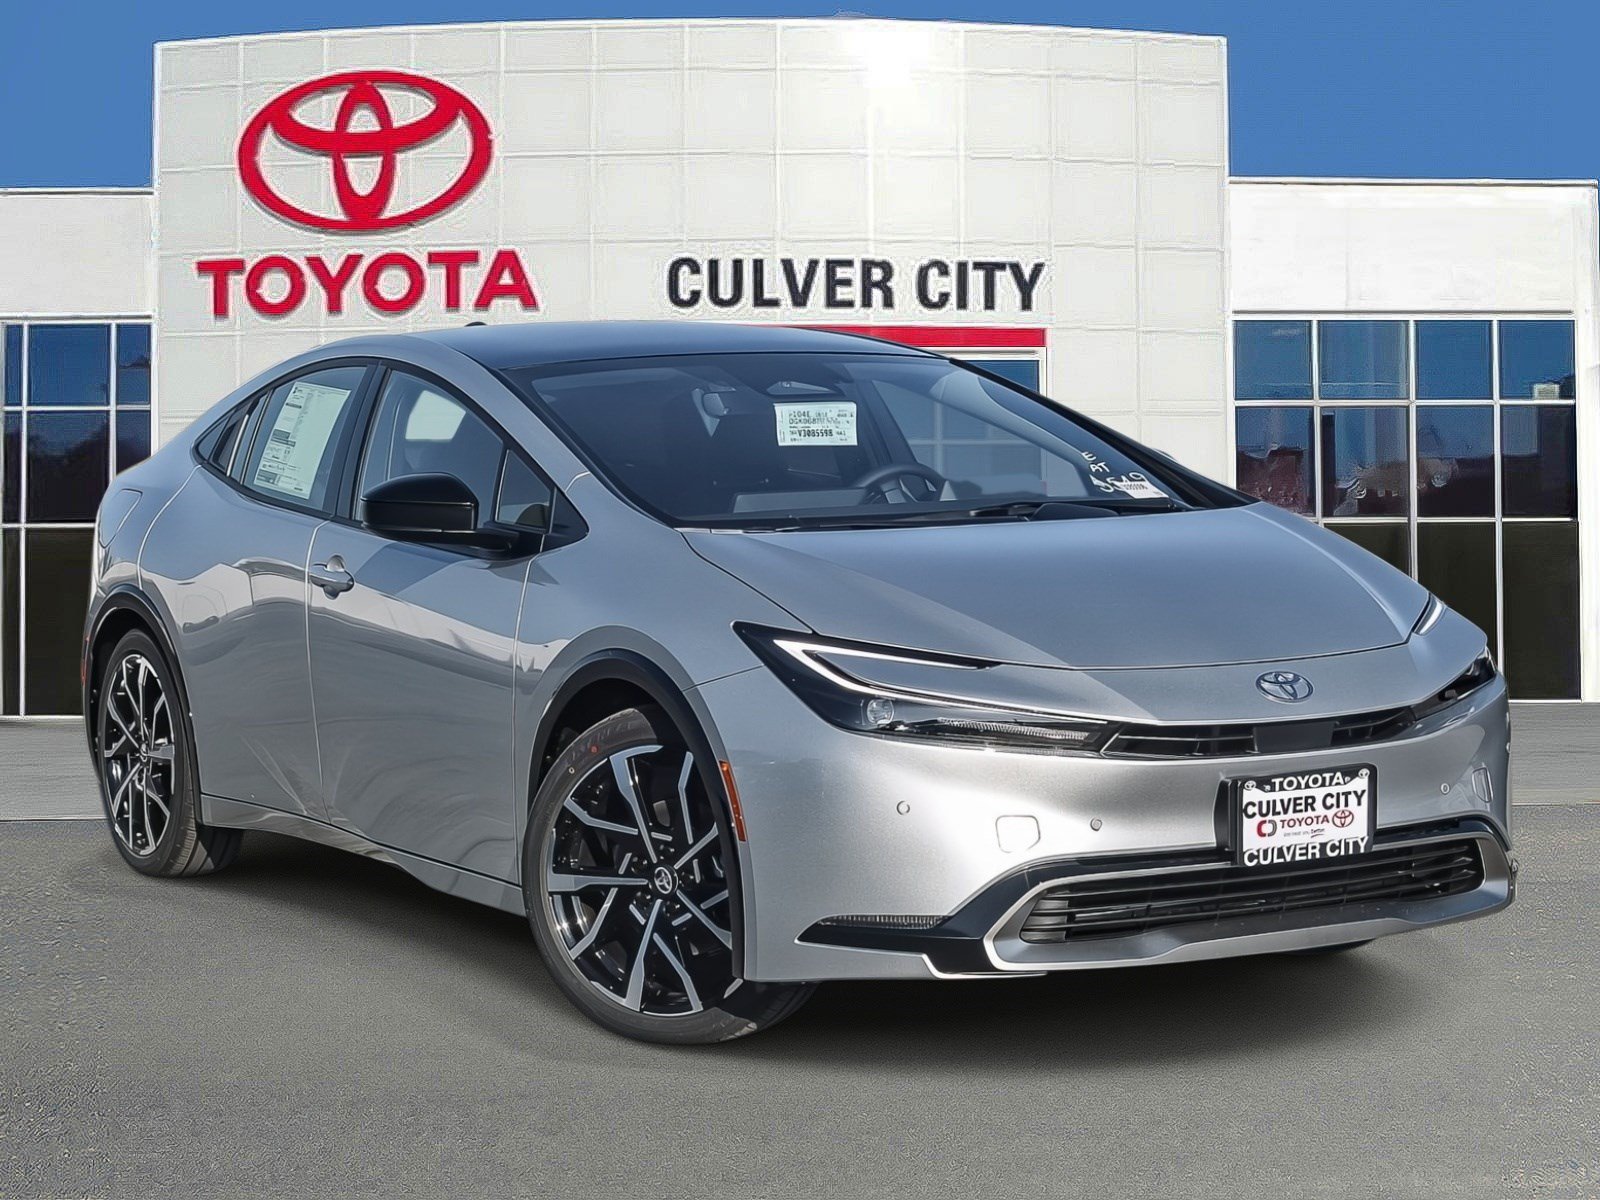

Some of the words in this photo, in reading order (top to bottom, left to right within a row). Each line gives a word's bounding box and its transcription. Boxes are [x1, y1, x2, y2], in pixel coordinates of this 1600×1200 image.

[197, 250, 540, 318] TOYOTA
[667, 256, 895, 309] CULVER
[915, 259, 1046, 311] CITY
[1271, 772, 1345, 792] TOYOTA
[1243, 795, 1317, 819] CULVER
[1321, 789, 1367, 811] CITY
[1280, 814, 1330, 829] TOYOTA
[1243, 842, 1320, 867] CULVER
[1326, 836, 1368, 857] CITY
